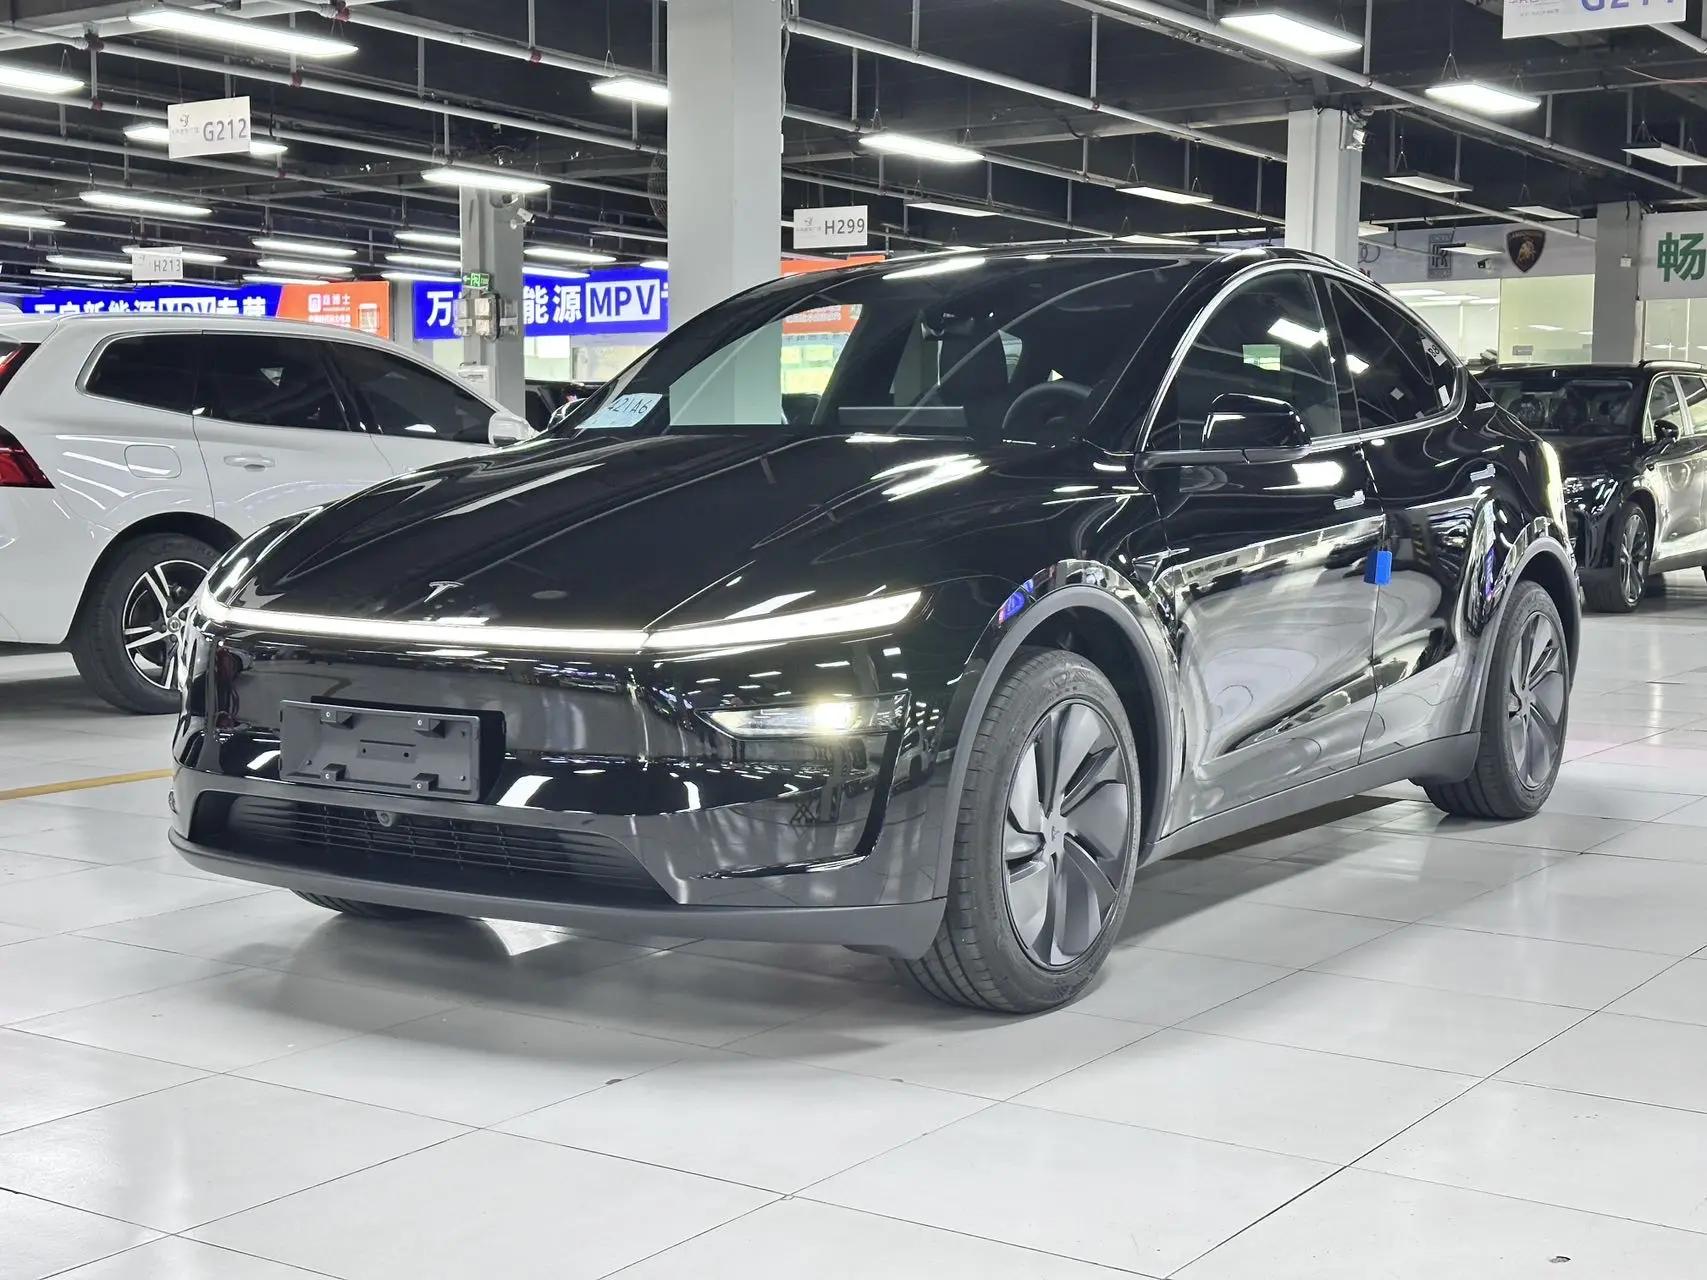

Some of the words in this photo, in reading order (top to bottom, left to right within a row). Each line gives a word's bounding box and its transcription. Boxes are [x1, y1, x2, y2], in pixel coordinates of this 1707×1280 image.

[203, 117, 247, 142] G212
[824, 217, 866, 235] H299
[153, 258, 181, 272] H213
[1657, 231, 1707, 282] 畅
[589, 284, 657, 318] MPV
